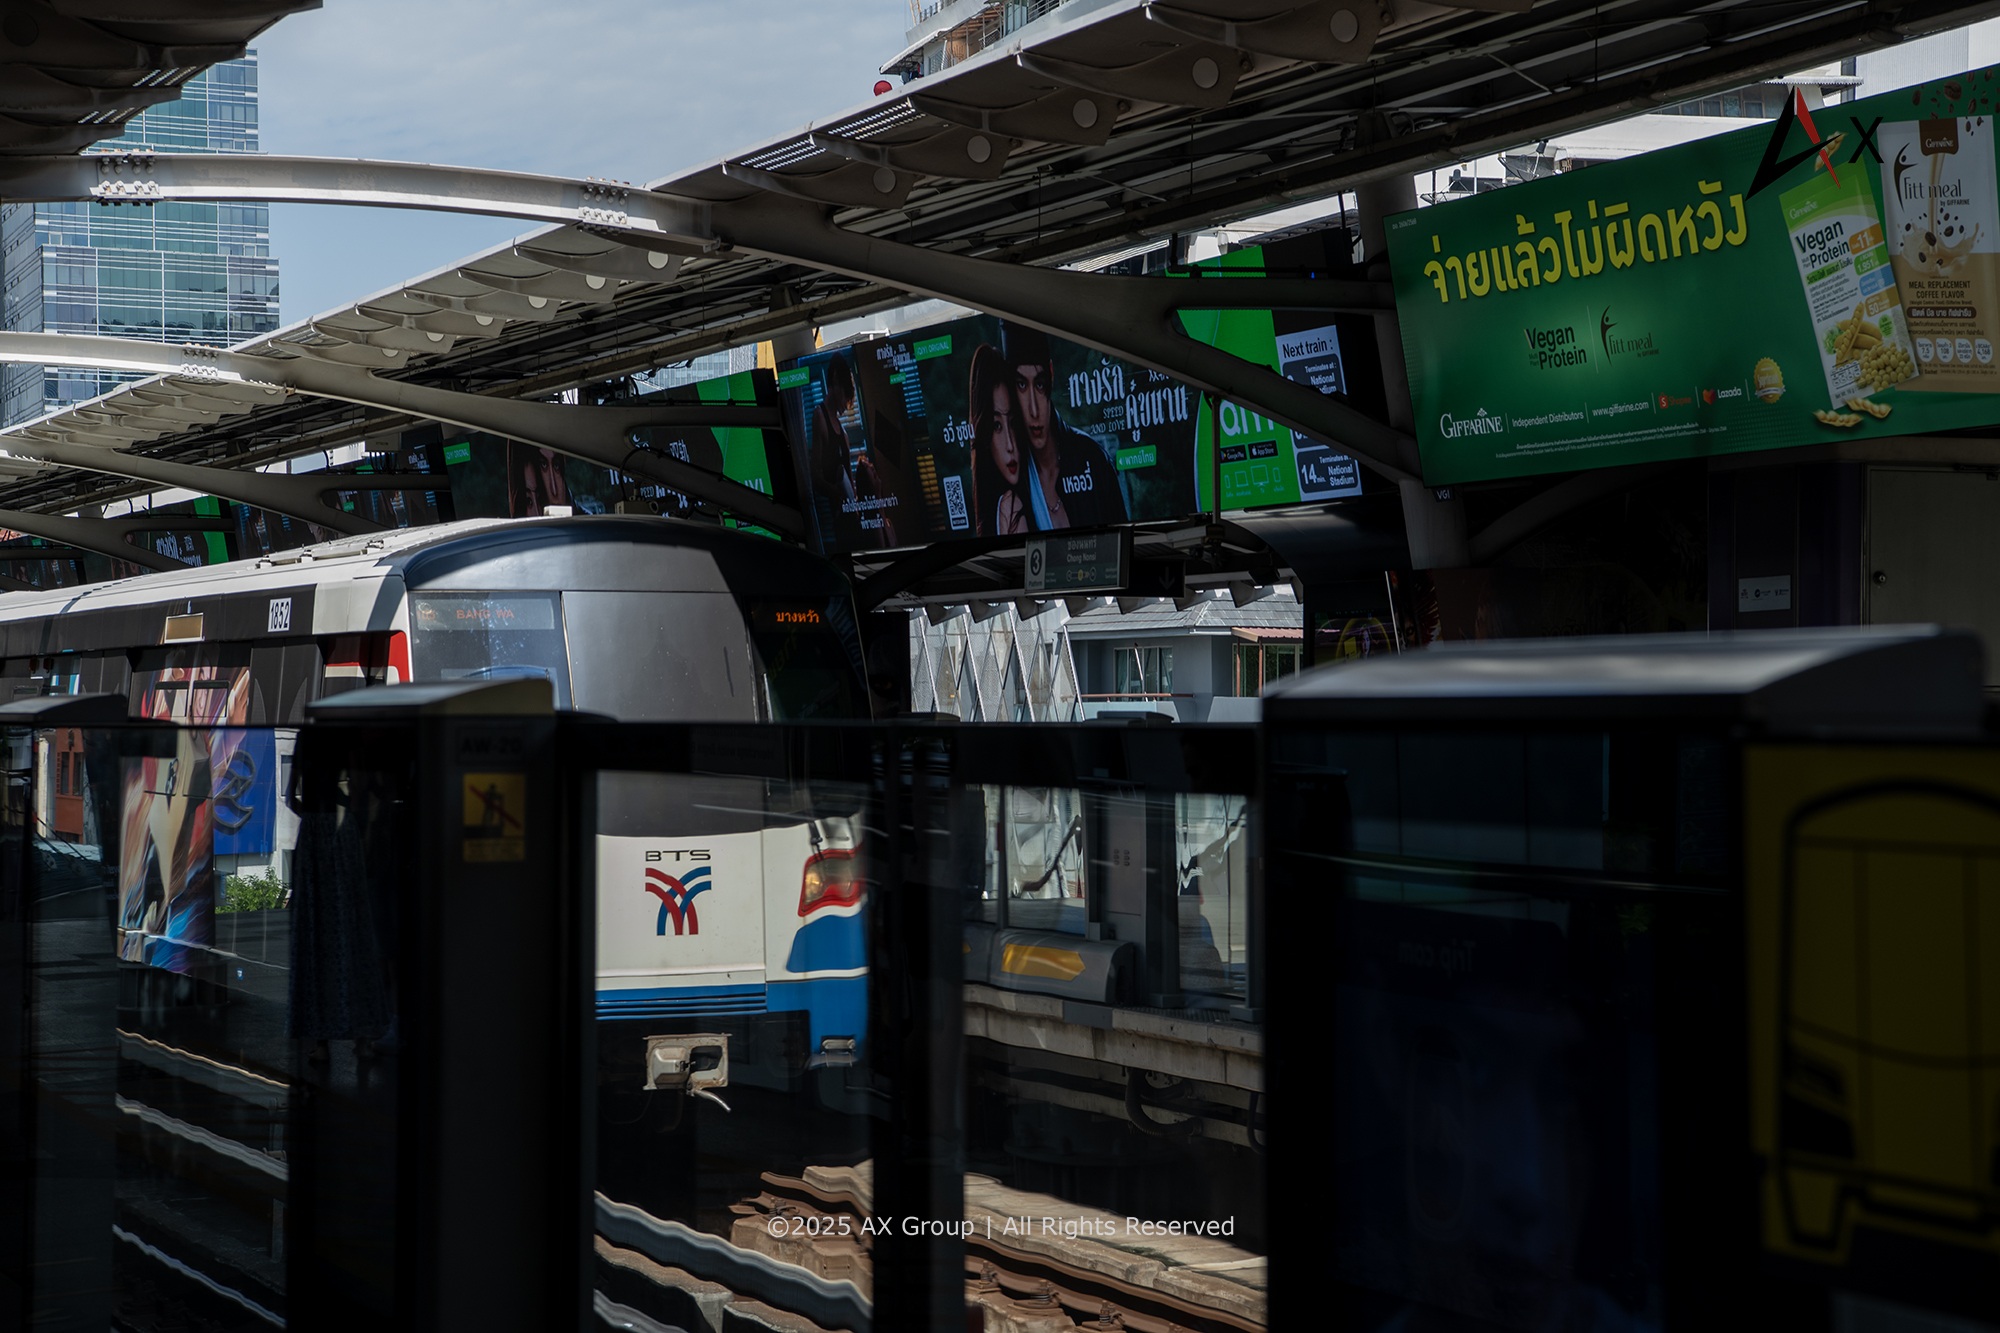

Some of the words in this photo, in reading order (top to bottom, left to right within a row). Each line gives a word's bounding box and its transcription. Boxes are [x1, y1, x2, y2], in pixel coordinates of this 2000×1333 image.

[1928, 179, 1962, 198] meal
[1424, 180, 1748, 303] จ่ายแล้วไม่ผิดหวัง
[1795, 221, 1844, 254] Vegan
[1810, 241, 1850, 269] Protein
[1909, 281, 1925, 289] MEAL
[1928, 281, 1970, 289] REPLACEMENT
[1916, 290, 1939, 299] COFFEE
[1941, 290, 1965, 299] FLAVOR
[1282, 341, 1305, 359] Next
[1306, 337, 1328, 355] train
[1524, 327, 1575, 352] Vegan
[1627, 332, 1653, 352] meal
[1538, 345, 1588, 370] Protein
[1068, 357, 1127, 408] ทางรัก
[1310, 371, 1336, 386] National
[1668, 396, 1692, 407] Shopee
[1717, 387, 1742, 399] Lazada
[1103, 405, 1124, 420] SPEED
[1592, 400, 1650, 417] www.giffarine.com
[1108, 419, 1126, 433] LOVE
[1440, 409, 1503, 439] GIFFARINE
[1512, 415, 1549, 429] Independent
[1549, 411, 1585, 424] Distributors
[1301, 463, 1317, 485] 14
[1327, 463, 1353, 477] National
[1329, 474, 1355, 487] Stadium
[1436, 489, 1450, 500] VGI
[1033, 551, 1041, 575] 3
[1066, 553, 1082, 565] Chong
[1082, 551, 1097, 562] Nonsi
[271, 601, 290, 629] 1852
[456, 609, 491, 620] BANG
[495, 609, 515, 620] WA
[775, 608, 820, 624] บางหว้า
[645, 849, 712, 862] BTS
